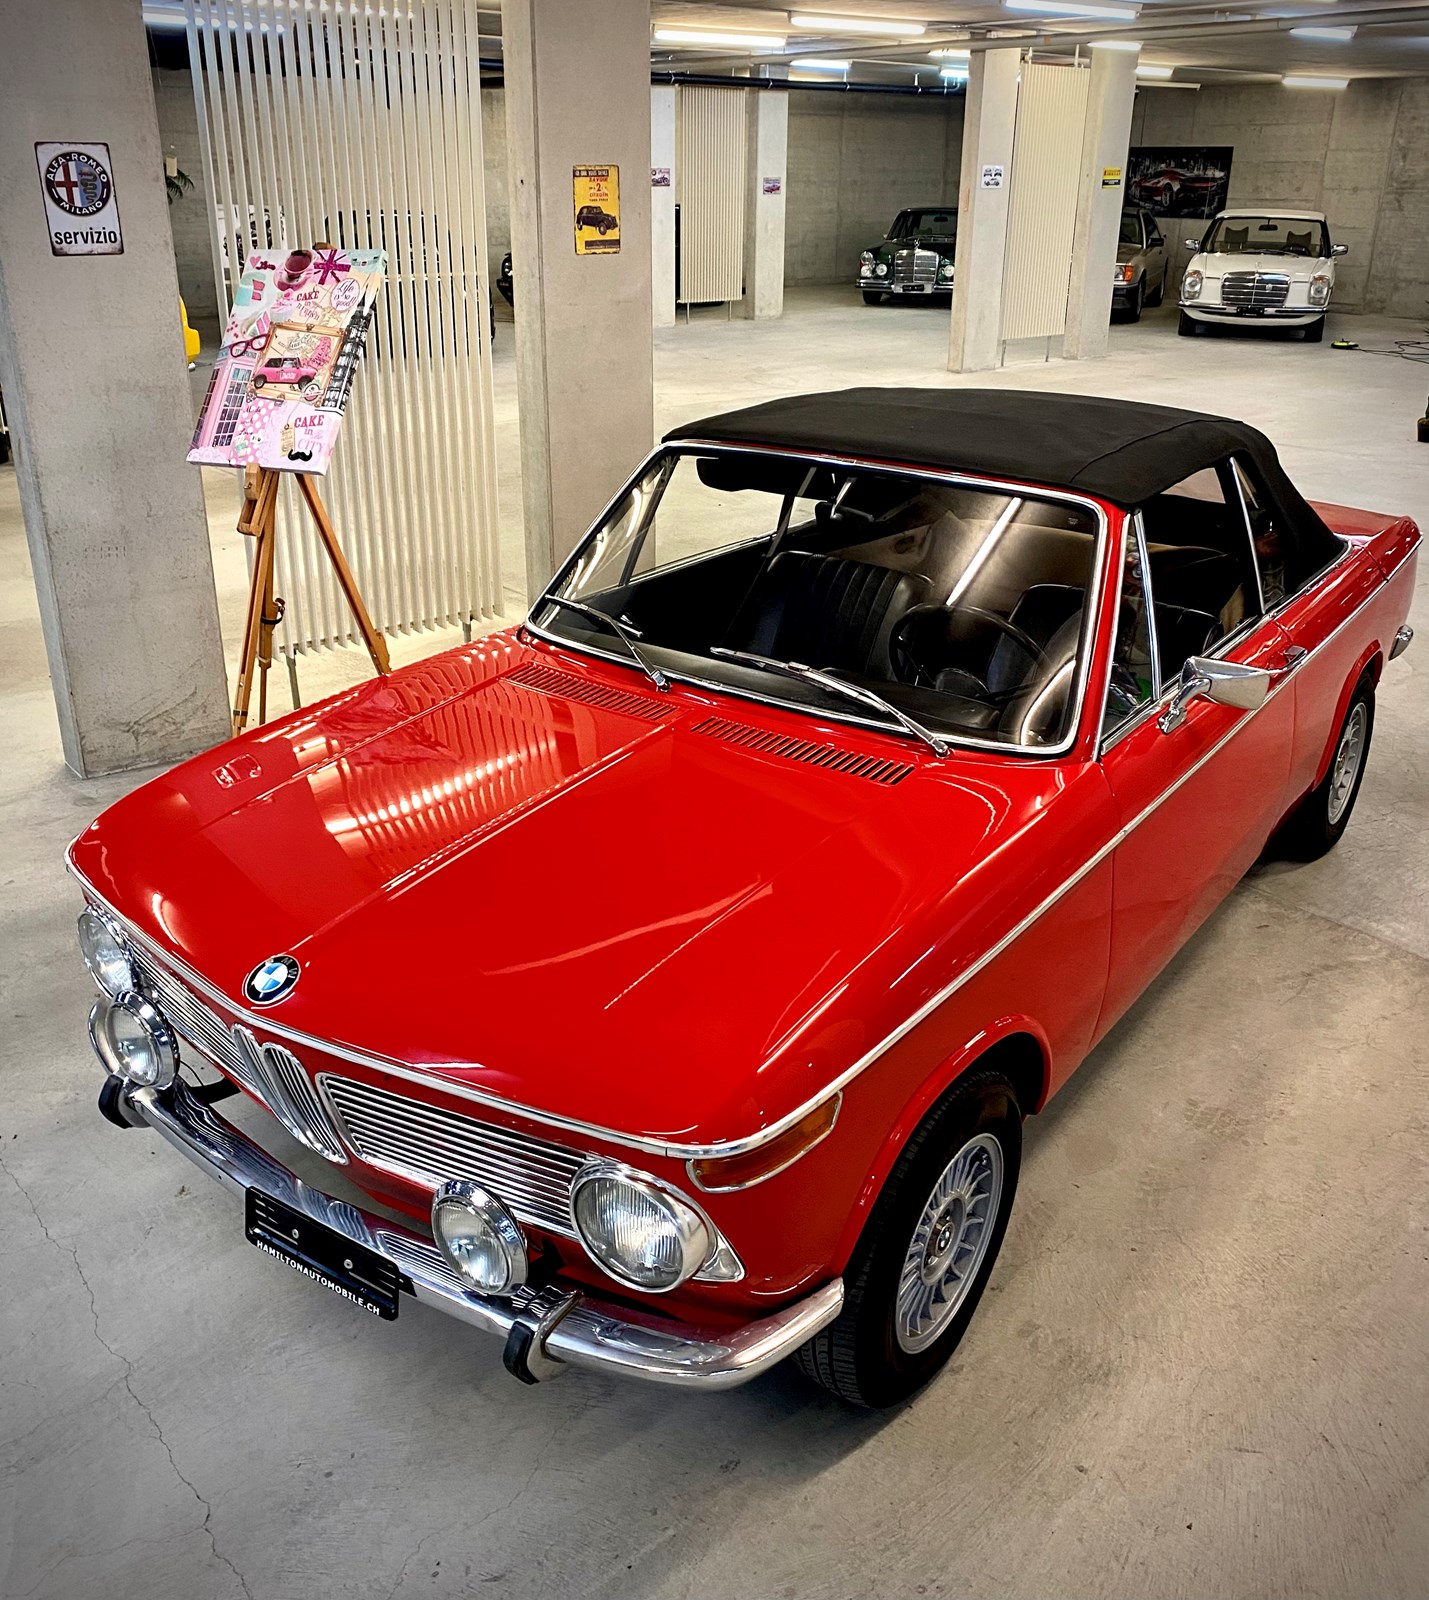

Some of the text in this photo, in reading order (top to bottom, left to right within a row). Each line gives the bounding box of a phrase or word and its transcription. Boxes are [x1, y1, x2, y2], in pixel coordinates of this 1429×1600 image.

[60, 200, 103, 215] MILANO
[54, 227, 117, 245] servizio
[296, 291, 320, 302] CAKE
[294, 414, 325, 429] CAKE
[304, 428, 313, 436] in
[297, 438, 325, 453] CITY
[256, 1240, 380, 1316] HAMILTONAUTOMOBILE.CH
